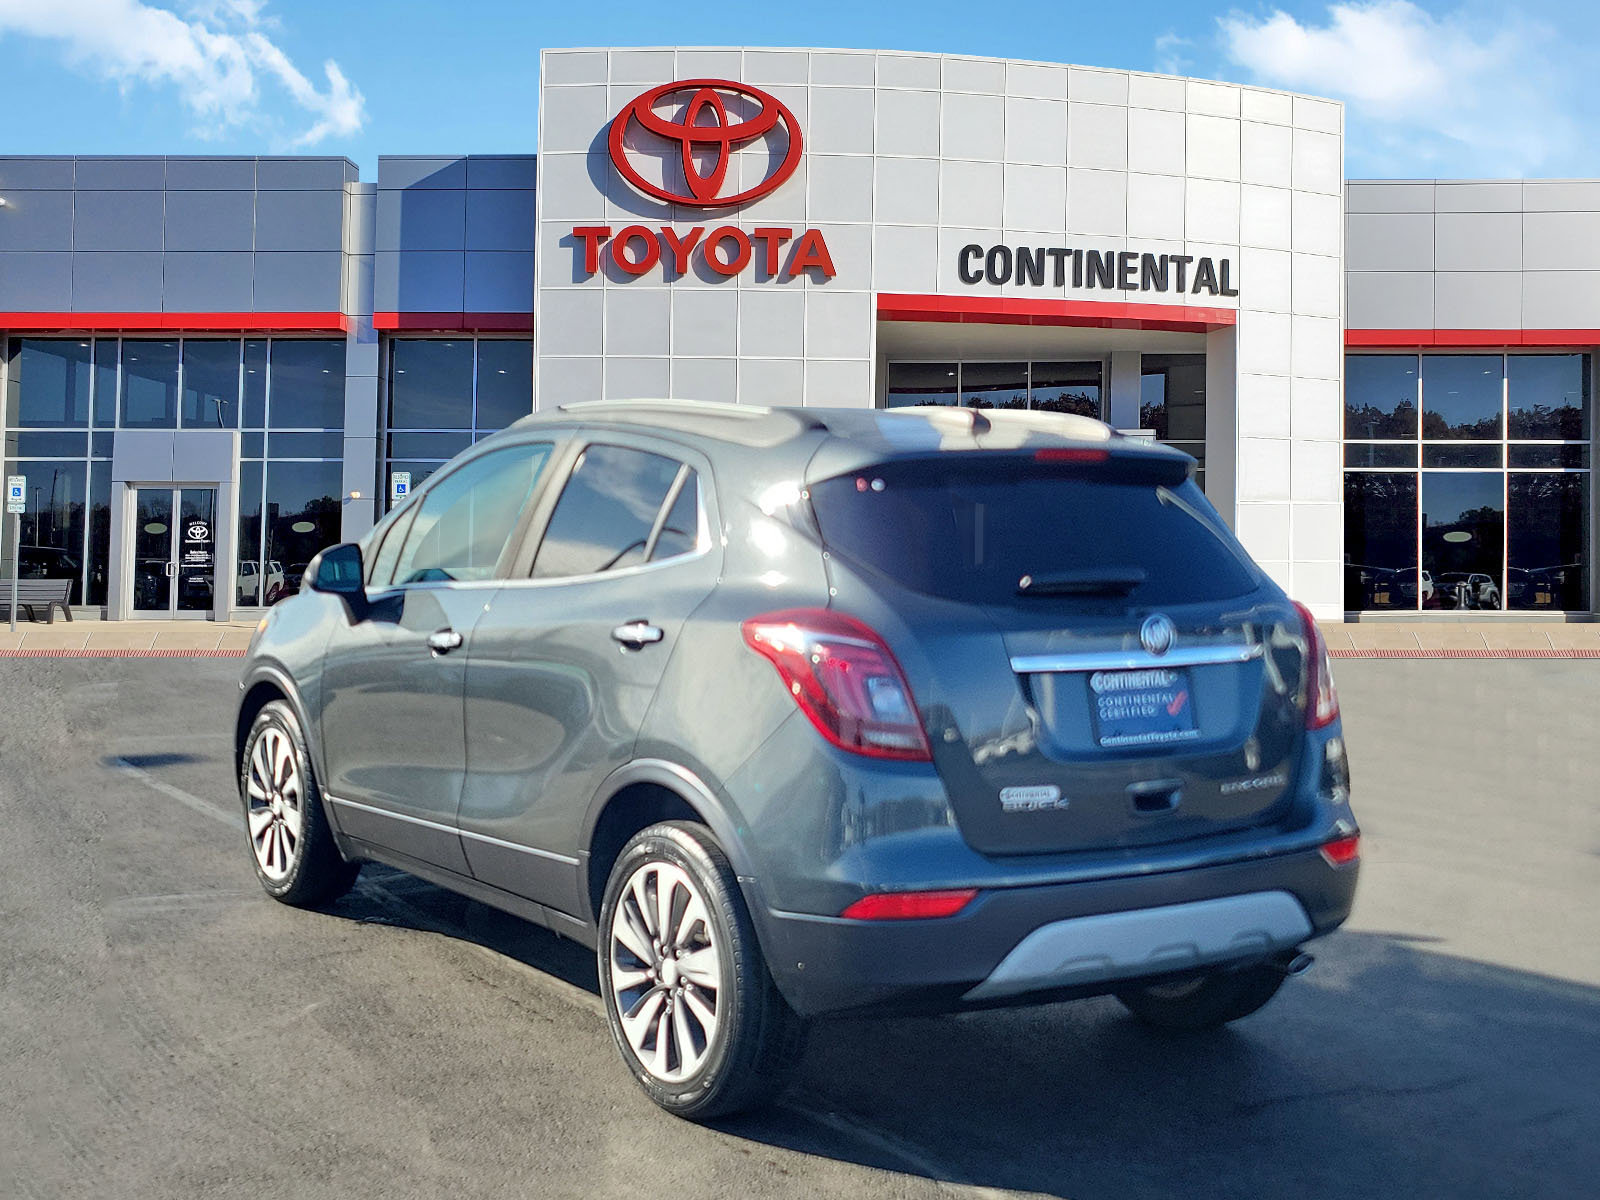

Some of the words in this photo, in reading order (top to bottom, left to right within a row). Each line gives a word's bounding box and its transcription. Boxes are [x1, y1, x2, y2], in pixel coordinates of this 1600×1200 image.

[572, 225, 837, 276] TOYOTA
[958, 243, 1239, 296] CONTINENTAL
[1094, 670, 1170, 692] CONTINENTAL
[1098, 693, 1174, 707] CONTINENTAL
[1099, 705, 1156, 720] CERTIFIED
